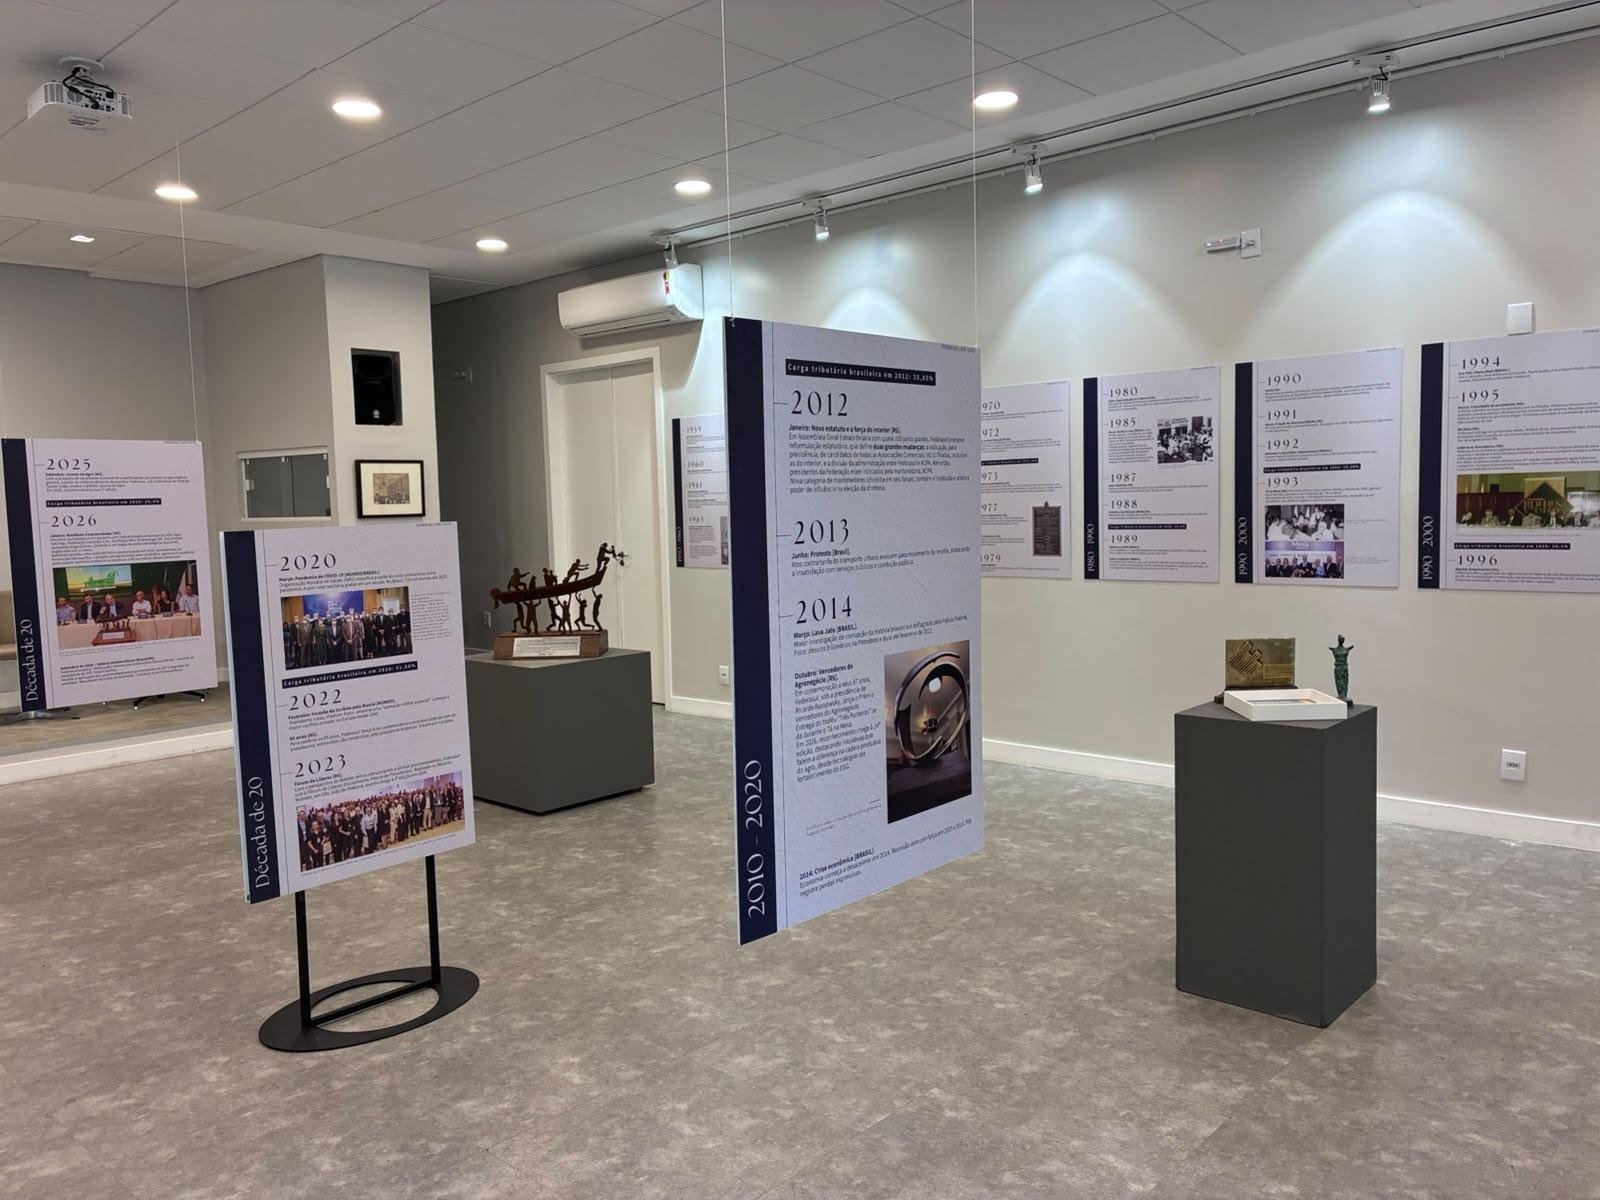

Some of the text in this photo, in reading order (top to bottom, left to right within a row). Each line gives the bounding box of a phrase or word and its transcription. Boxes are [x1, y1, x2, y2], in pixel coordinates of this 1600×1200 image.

[1462, 356, 1500, 370] 1994
[787, 362, 808, 373] Carga
[811, 364, 846, 376] tributária
[849, 367, 881, 378] brasileira
[1267, 373, 1301, 386] 1990
[1109, 387, 1138, 398] 1980
[1462, 389, 1499, 403] 1995
[790, 389, 847, 417] 2012
[981, 400, 1001, 411] 970
[1267, 409, 1296, 420] 1991
[788, 423, 810, 431] Janeiro:
[811, 424, 823, 432] Novo
[1109, 417, 1136, 428] 1985
[981, 428, 1000, 438] 972
[1267, 438, 1299, 450] 1992
[46, 458, 90, 471] 2025
[1110, 473, 1136, 483] 1987
[1267, 477, 1298, 488] 1993
[980, 503, 998, 513] 977
[1110, 500, 1138, 509] 1988
[50, 514, 96, 527] 2026
[793, 518, 849, 548] 2013
[1110, 534, 1138, 544] 1989
[1087, 523, 1095, 572] 1980 1990
[1238, 517, 1247, 575] 1990 2000
[1422, 515, 1433, 580] 1990 2000
[791, 550, 808, 560] Junho:
[810, 549, 831, 558] Protesto
[1458, 554, 1498, 566] 1996
[279, 552, 336, 571] 2020
[796, 594, 851, 624] 2014
[793, 630, 810, 639] Março:
[812, 628, 823, 637] Lava
[824, 626, 835, 635] Jato
[20, 619, 38, 701] Década de 20
[818, 664, 845, 675] Vencedores
[795, 676, 826, 689] Agronegócio
[288, 688, 341, 711] 2022
[294, 753, 345, 779] 2023
[744, 759, 763, 831] 2020
[248, 776, 270, 888] Década de 20
[814, 863, 826, 875] Crise
[828, 854, 853, 871] econômica
[746, 853, 765, 918] 2010
